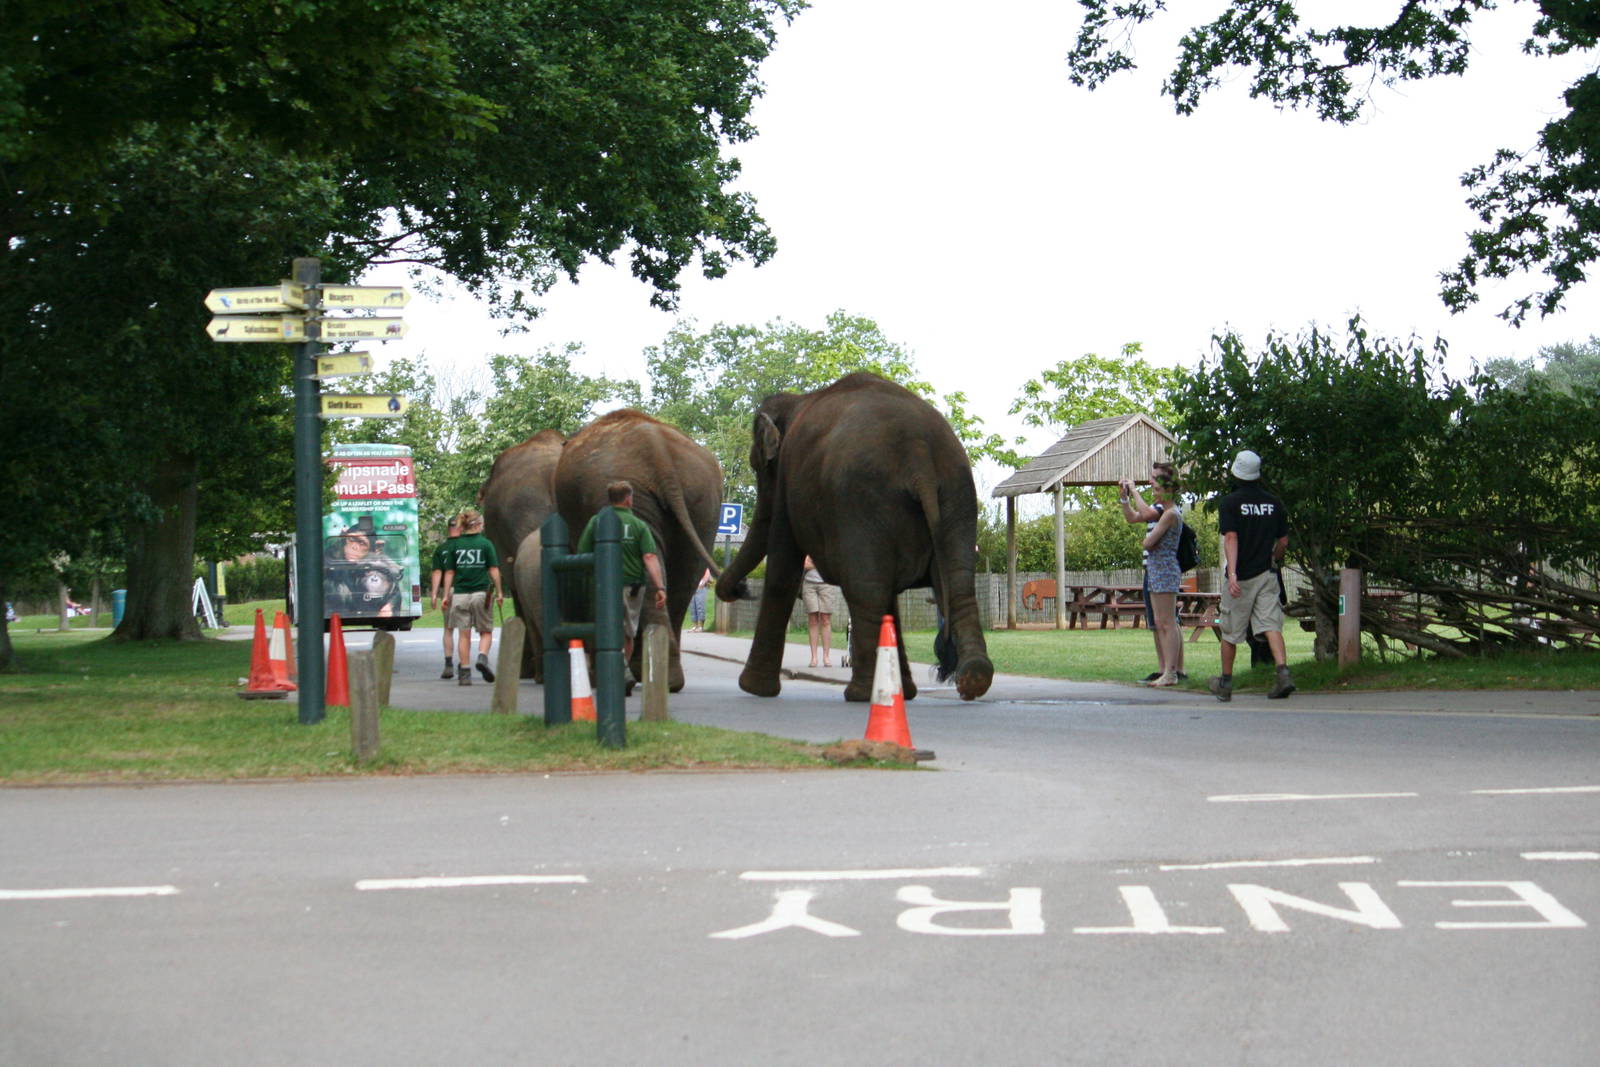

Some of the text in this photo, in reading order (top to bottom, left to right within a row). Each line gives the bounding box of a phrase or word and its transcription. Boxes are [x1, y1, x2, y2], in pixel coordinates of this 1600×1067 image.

[377, 479, 414, 495] Pass
[722, 506, 737, 524] P
[1240, 503, 1275, 516] STAFF
[455, 549, 486, 565] ZSL
[709, 879, 1588, 940] ENTRY
